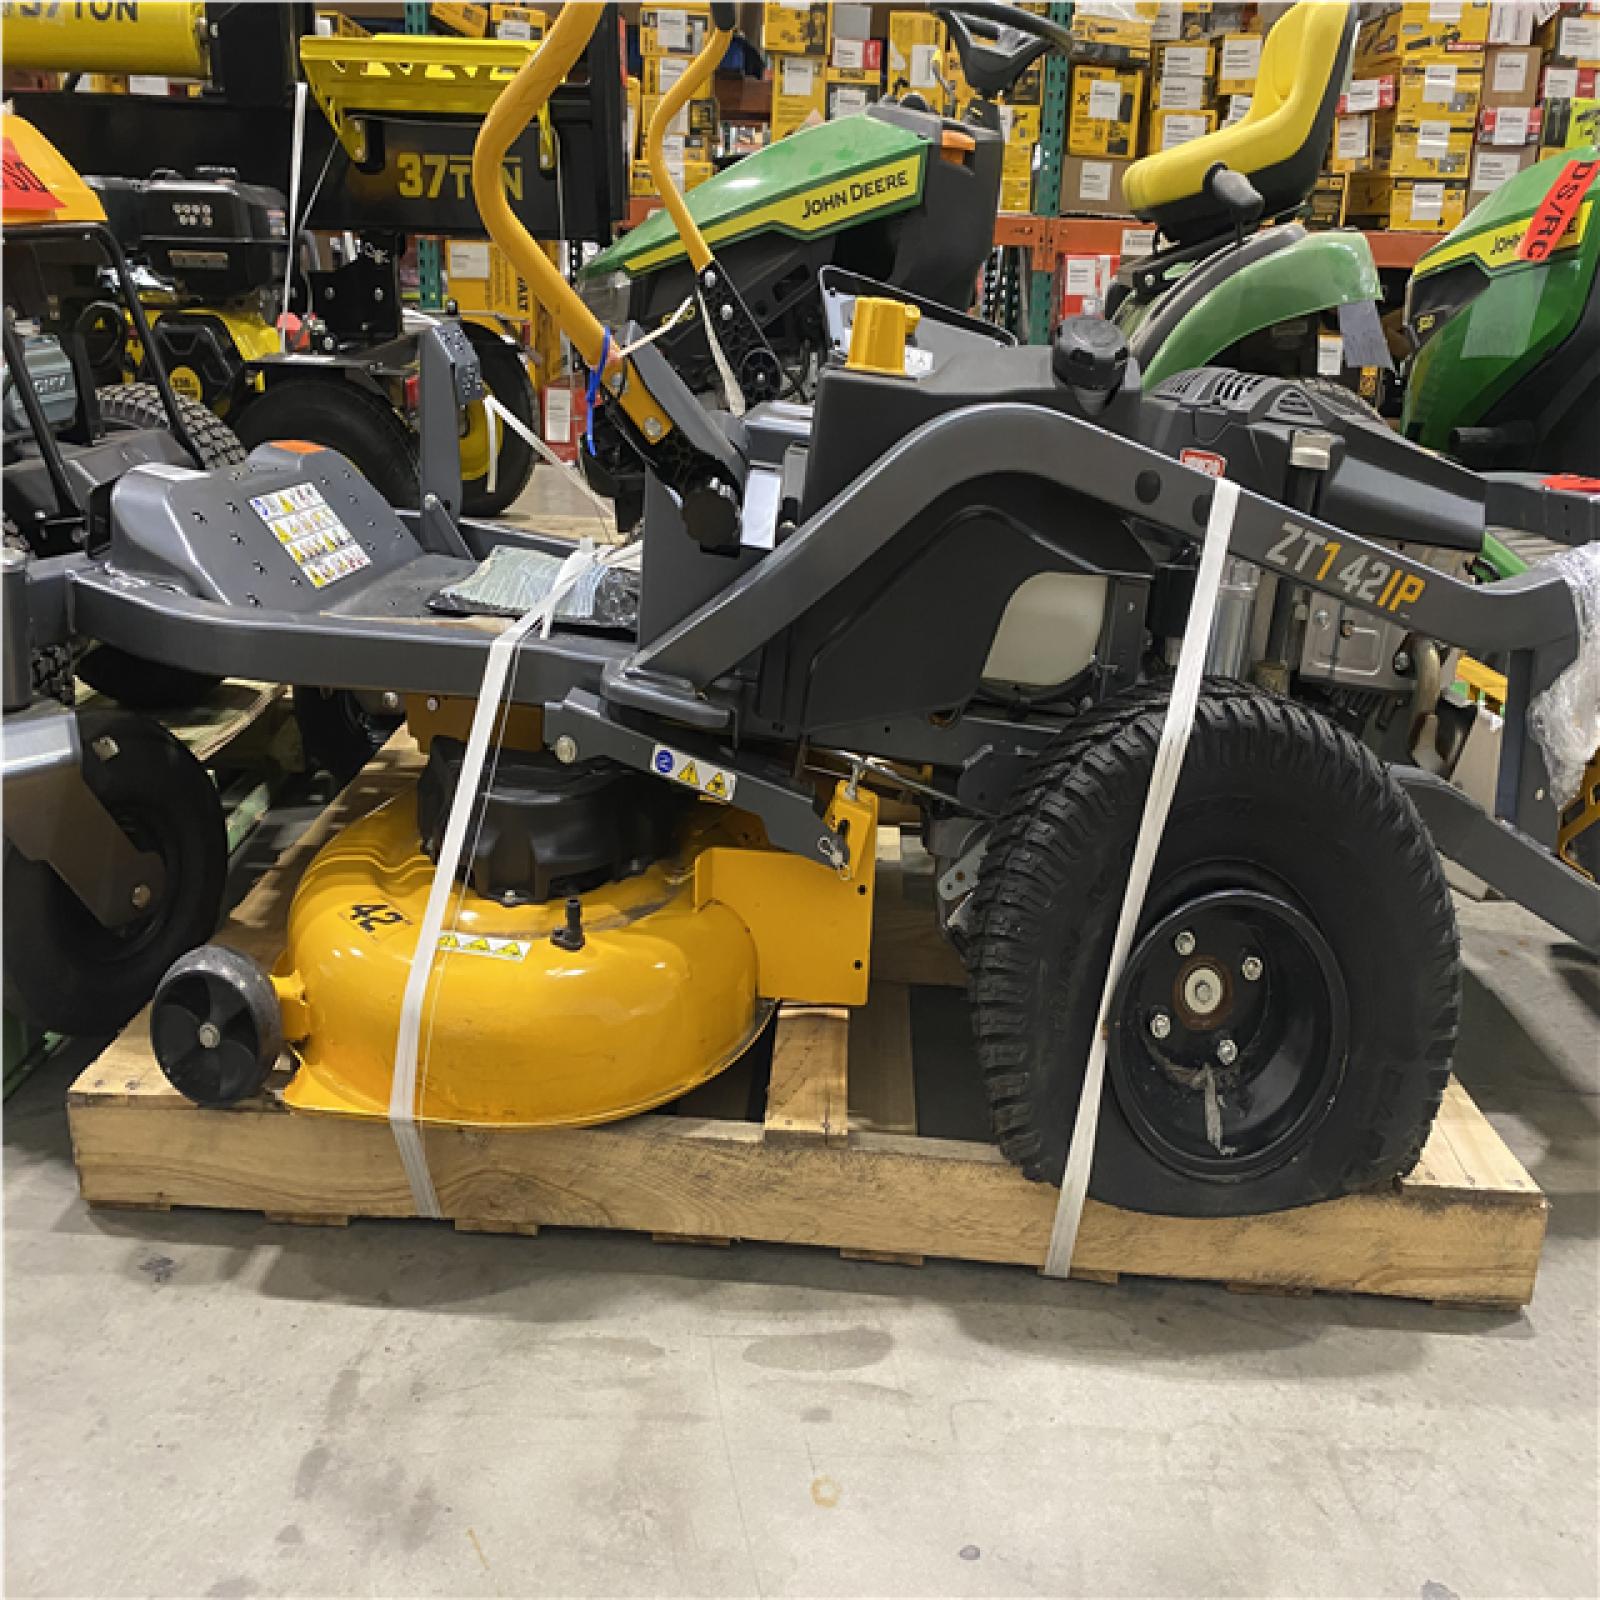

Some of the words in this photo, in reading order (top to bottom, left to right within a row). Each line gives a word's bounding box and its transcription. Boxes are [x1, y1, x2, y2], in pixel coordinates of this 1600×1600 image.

[397, 153, 523, 200] 37TN
[802, 189, 848, 220] JOHN
[850, 169, 909, 202] DEERE
[1265, 521, 1341, 581] ZT1
[1337, 554, 1425, 613] 42IP
[350, 904, 403, 932] 42
